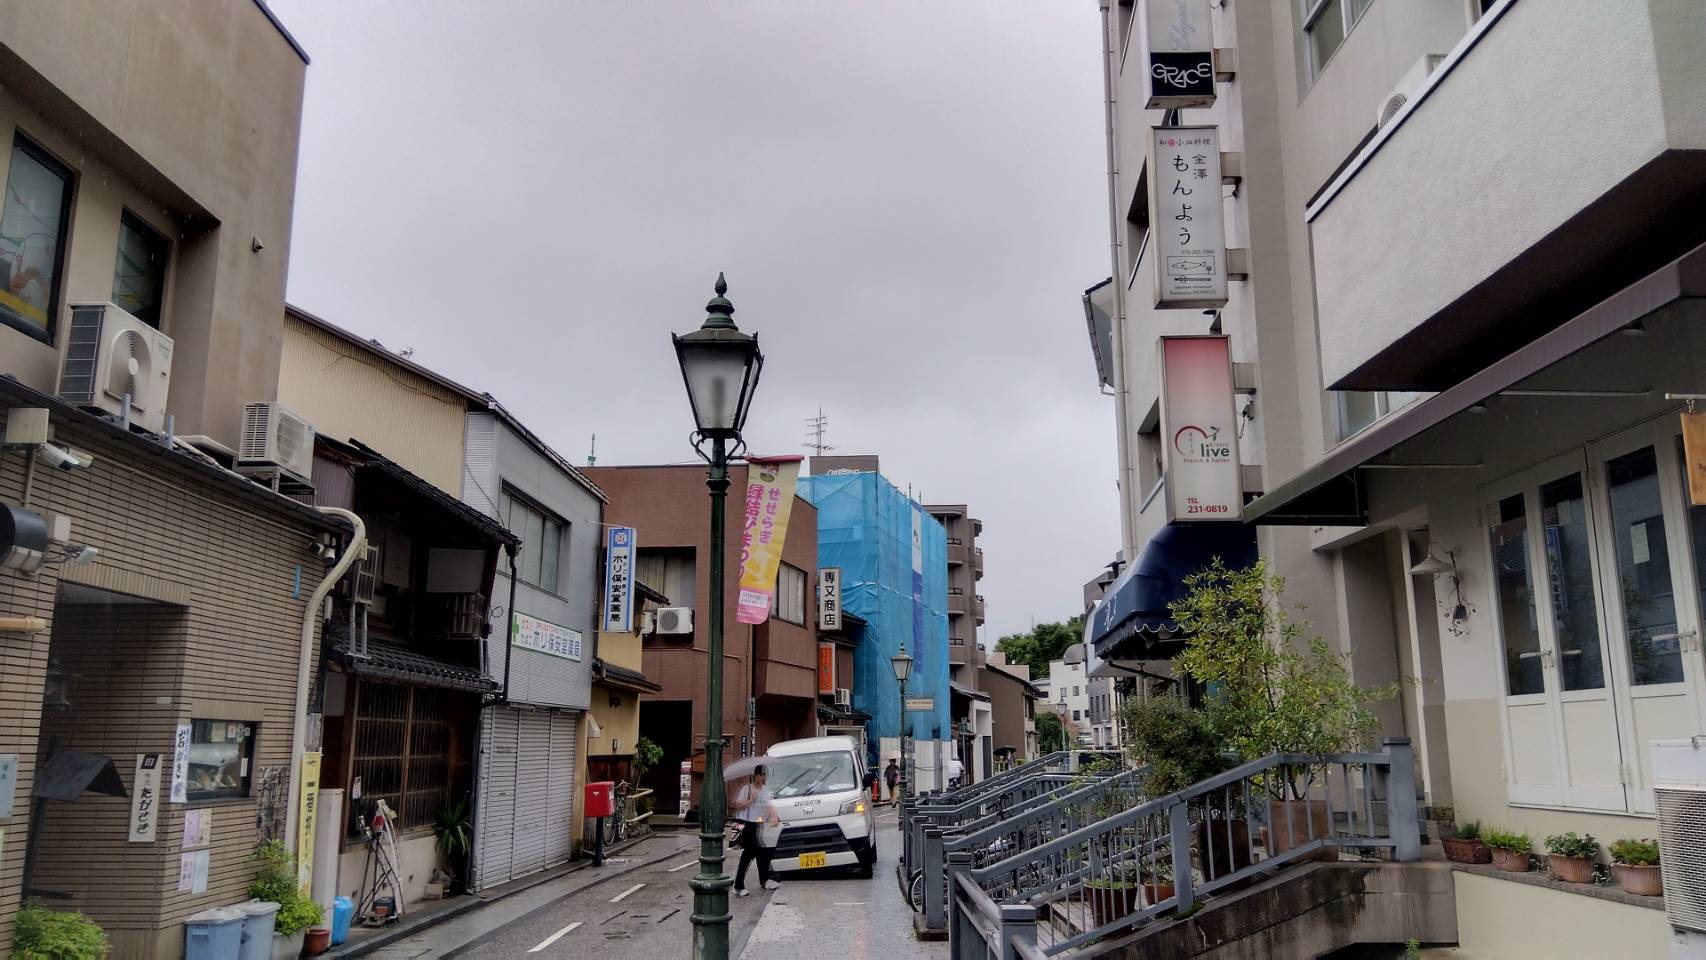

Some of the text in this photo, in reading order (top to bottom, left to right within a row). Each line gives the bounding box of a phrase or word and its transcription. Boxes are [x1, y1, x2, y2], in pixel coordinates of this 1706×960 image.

[1151, 62, 1211, 88] GRACE
[1172, 154, 1193, 245] もんよう
[1187, 505, 1228, 513] 231-0819
[794, 799, 822, 807] DUSKIN
